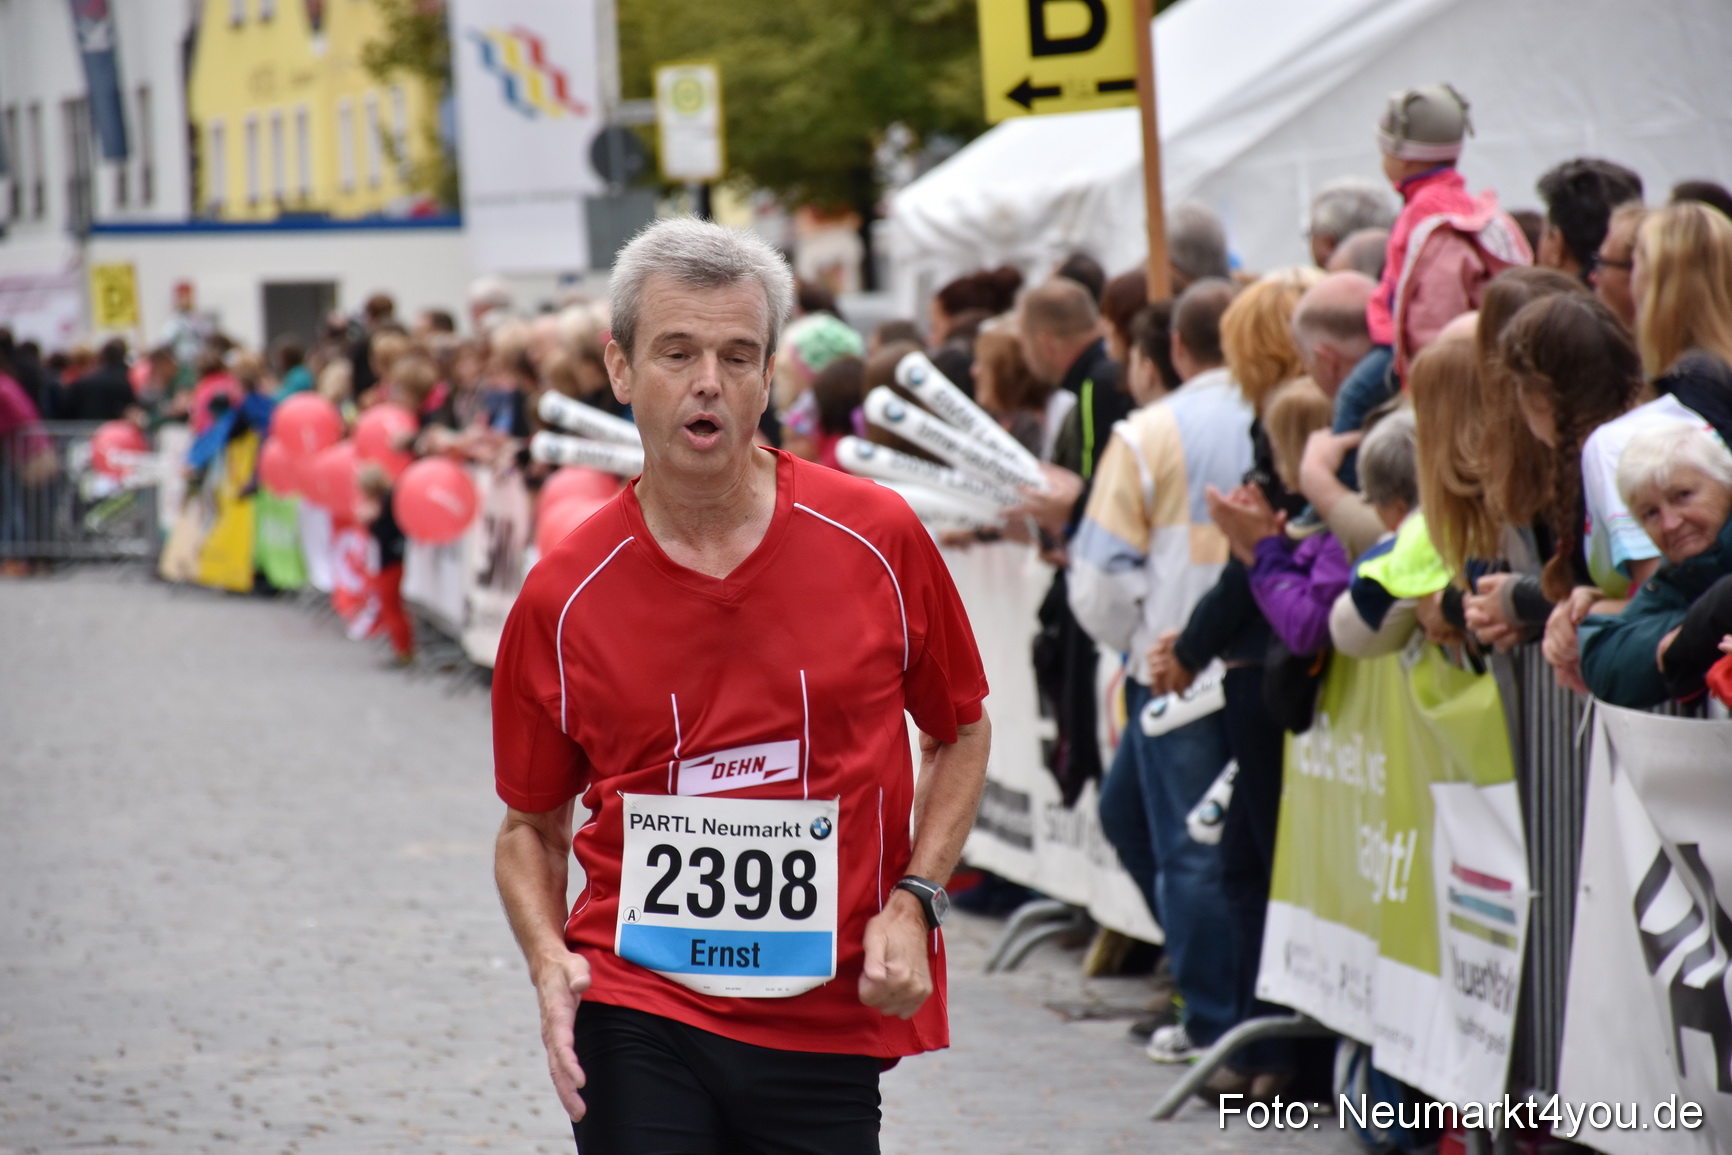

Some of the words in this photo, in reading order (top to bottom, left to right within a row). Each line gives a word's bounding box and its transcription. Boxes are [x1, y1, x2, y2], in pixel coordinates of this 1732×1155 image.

[711, 755, 766, 780] DEHN
[629, 813, 696, 834] PARTL
[702, 818, 802, 838] Neumarkt
[643, 843, 818, 921] 2398
[627, 909, 637, 922] A
[690, 939, 761, 968] Ernst
